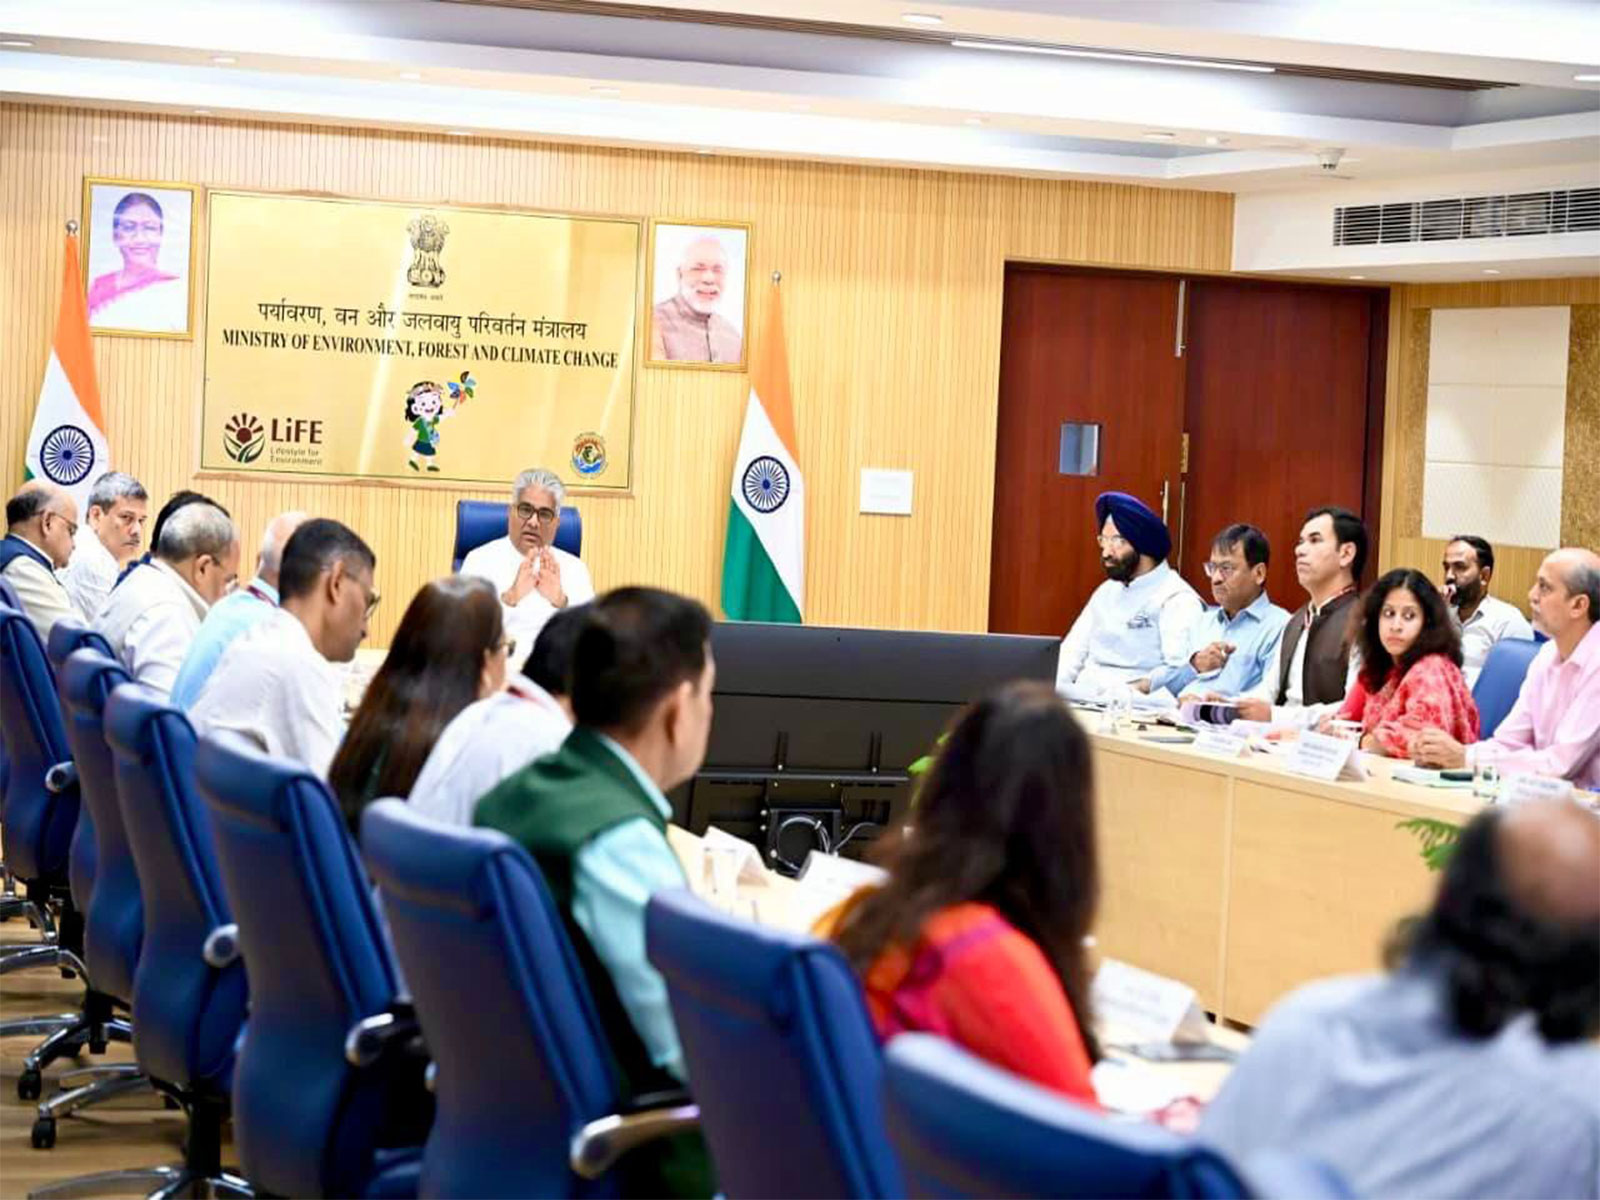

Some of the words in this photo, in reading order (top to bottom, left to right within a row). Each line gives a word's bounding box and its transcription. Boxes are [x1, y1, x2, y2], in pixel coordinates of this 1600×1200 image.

[258, 297, 326, 326] पर्यावरण,
[334, 308, 359, 326] वन
[367, 302, 396, 327] और
[402, 311, 461, 338] जलवायु
[468, 311, 526, 337] परिवर्तन
[532, 316, 587, 340] मंत्रालय
[222, 329, 288, 348] MINISTRY
[291, 334, 310, 349] OF
[313, 335, 415, 357] ENVIRONMENT,
[418, 342, 468, 360] FOREST
[472, 344, 498, 361] AND
[501, 346, 561, 365] CLIMATE
[563, 350, 619, 369] CHANGE
[271, 417, 323, 444] LiFE
